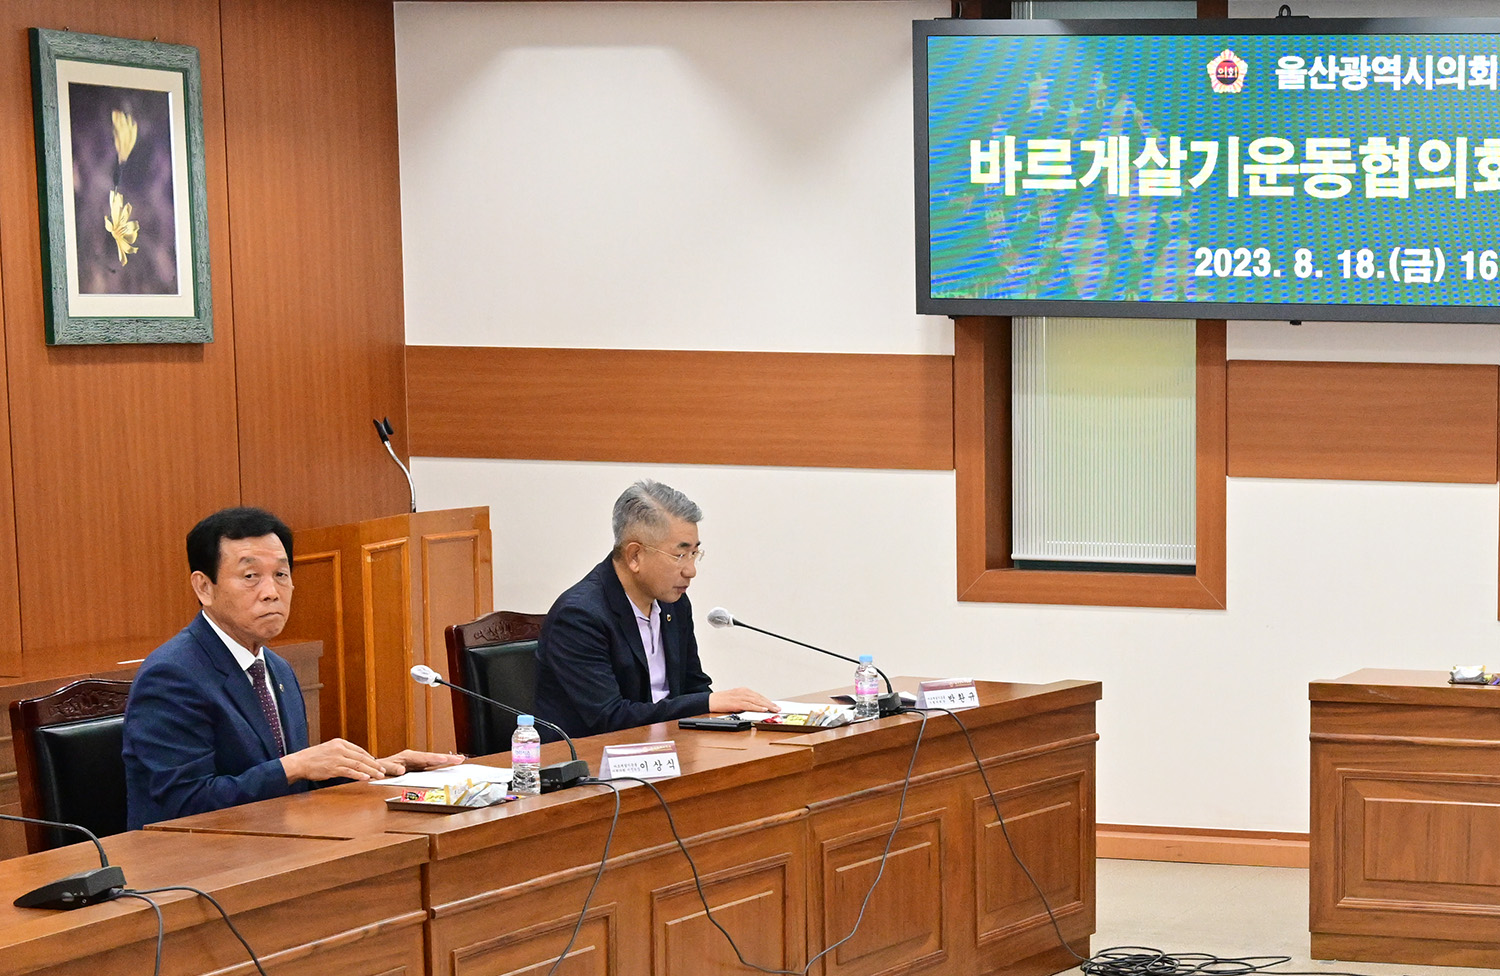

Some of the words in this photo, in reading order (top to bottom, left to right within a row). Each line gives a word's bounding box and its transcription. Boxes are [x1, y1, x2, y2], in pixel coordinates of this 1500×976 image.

[1274, 54, 1498, 92] 울산광역시의회
[1193, 246, 1282, 279] 2023.
[1293, 247, 1324, 279] 8.
[1336, 246, 1447, 285] 18.(금)
[639, 758, 676, 772] 이상식
